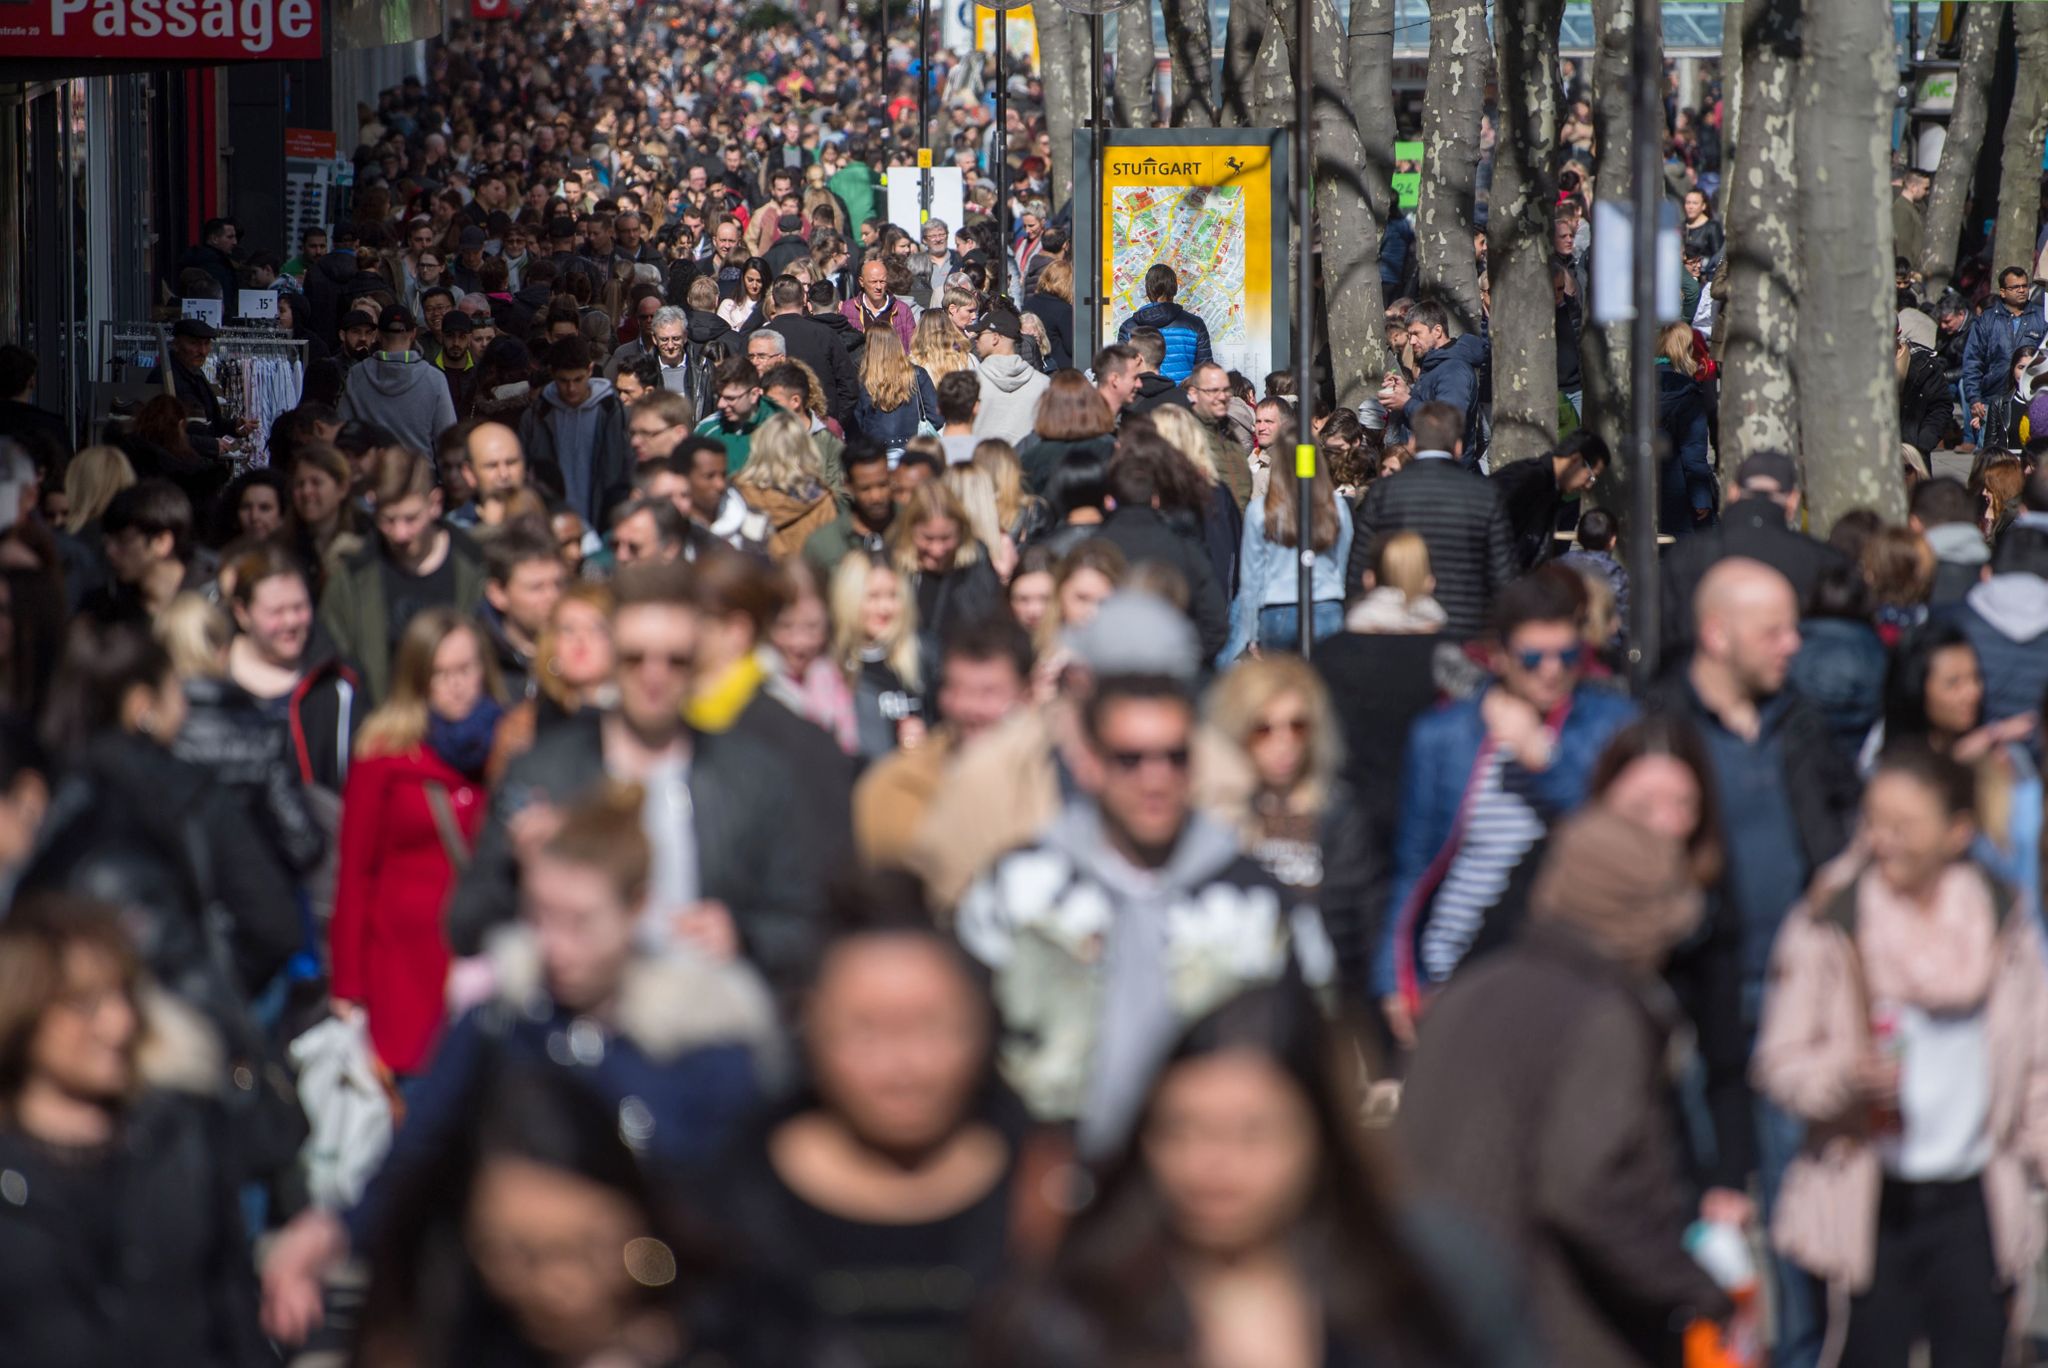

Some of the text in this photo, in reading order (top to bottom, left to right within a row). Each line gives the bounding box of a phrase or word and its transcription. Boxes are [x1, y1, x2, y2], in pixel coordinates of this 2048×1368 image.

[51, 0, 313, 52] Passage
[1928, 79, 1952, 97] WC
[1113, 157, 1202, 176] STUTTGART
